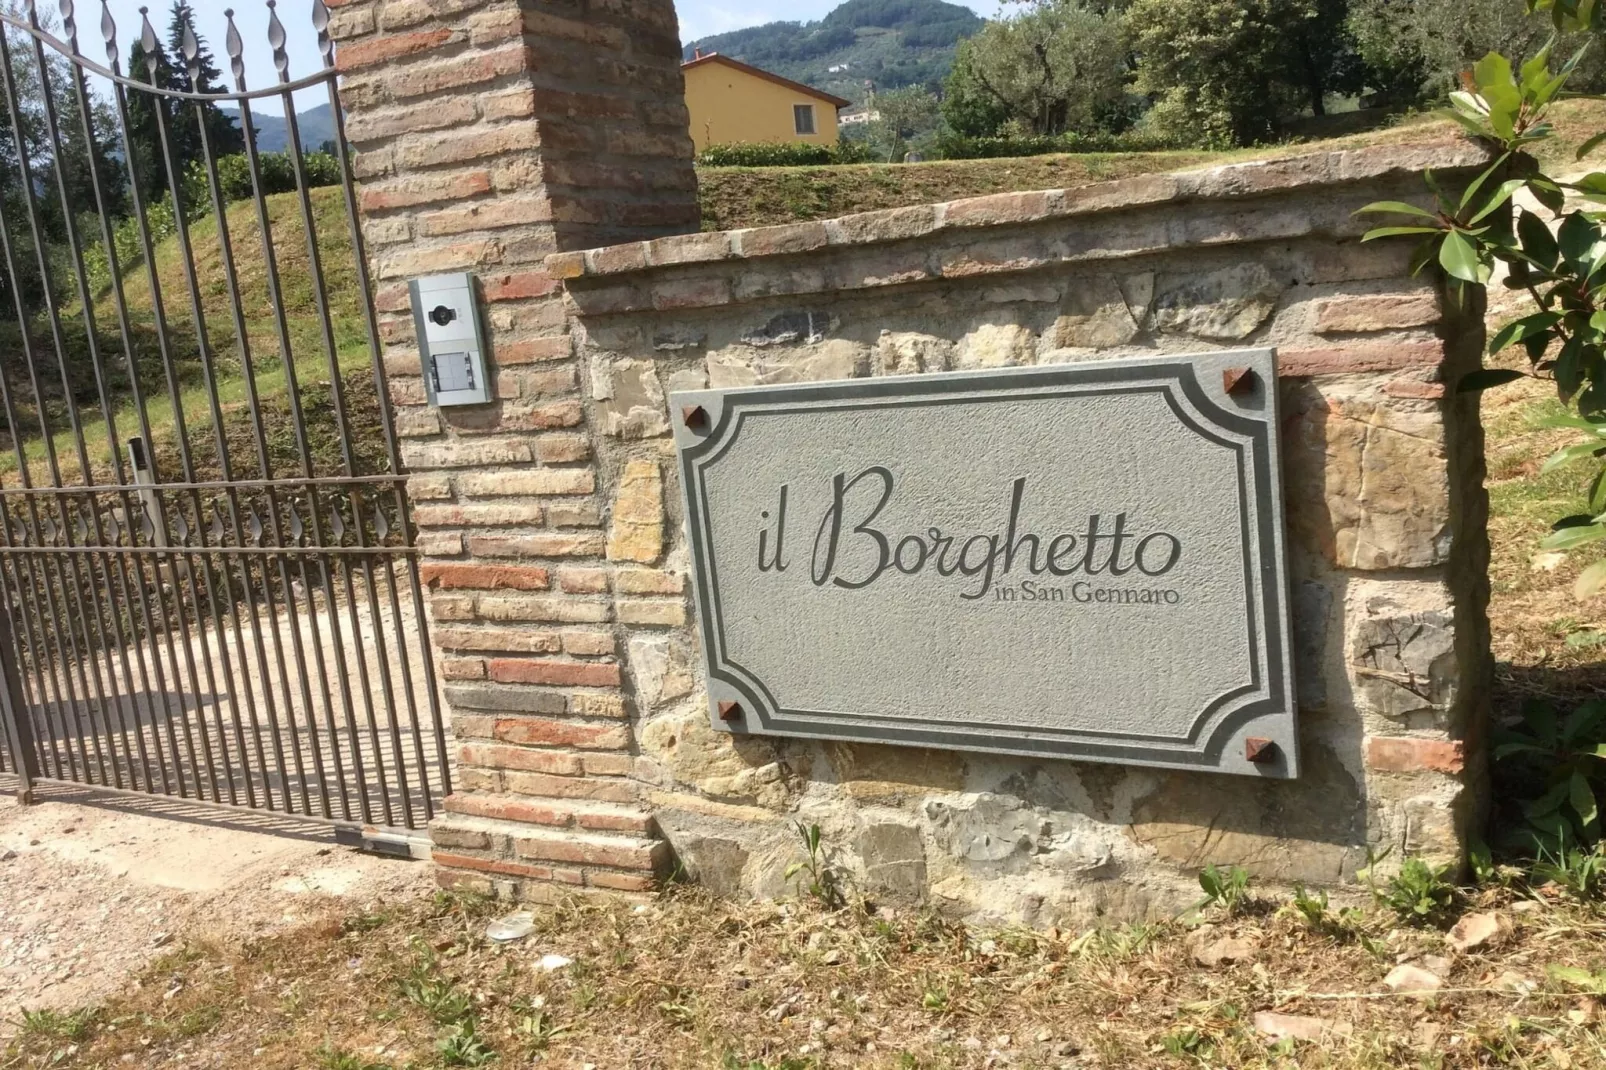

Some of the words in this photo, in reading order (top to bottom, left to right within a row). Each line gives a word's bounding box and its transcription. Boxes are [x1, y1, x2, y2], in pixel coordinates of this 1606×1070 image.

[757, 484, 791, 572] il
[811, 466, 1182, 600] Borghetto
[995, 581, 1015, 601] in
[1021, 581, 1065, 602] San
[1072, 582, 1181, 605] Gennaro
